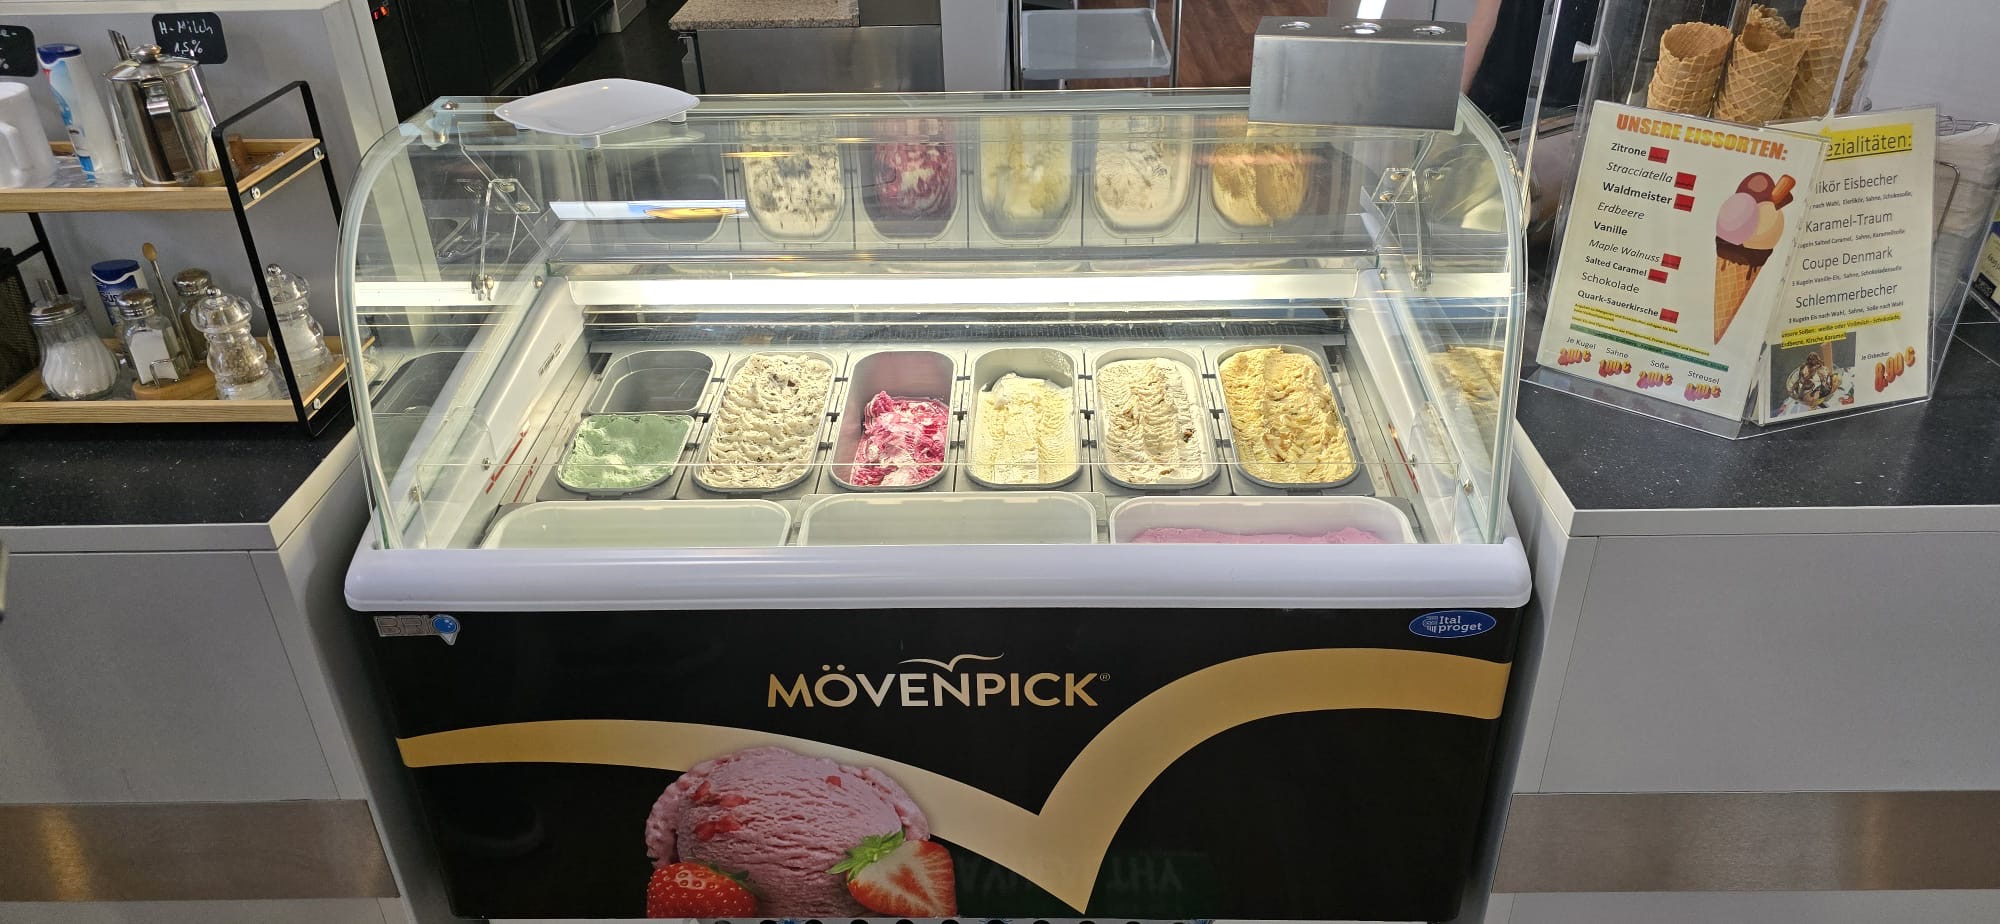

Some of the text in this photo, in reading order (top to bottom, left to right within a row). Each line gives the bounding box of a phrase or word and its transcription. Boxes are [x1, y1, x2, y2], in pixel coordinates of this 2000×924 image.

[1616, 113, 1788, 160] UNSERE EISSORTEN:
[1611, 142, 1647, 156] Zitrone
[1606, 161, 1673, 183] Stracciatella
[1844, 174, 1898, 191] Eisbecher
[1603, 181, 1673, 205] Waldmeister
[1597, 201, 1645, 220] Erdbeere
[1593, 220, 1628, 236] Vanille
[1805, 210, 1893, 233] Karamel-Traum
[1588, 239, 1661, 263] Maple Walnuss
[1802, 246, 1893, 272] Coupe Denmark
[1585, 255, 1648, 277] Salted Caramel
[1581, 271, 1640, 294] Schokolade
[1577, 289, 1659, 317] Quark-Sauerkirsche
[1795, 283, 1898, 309] Schlemmerbecher
[1566, 336, 1597, 350] Je Kugel
[1606, 347, 1629, 358] Sahne
[1650, 360, 1669, 370] Soße
[1688, 370, 1720, 384] Streusel
[1438, 622, 1482, 634] proget
[1439, 615, 1461, 625] Ital
